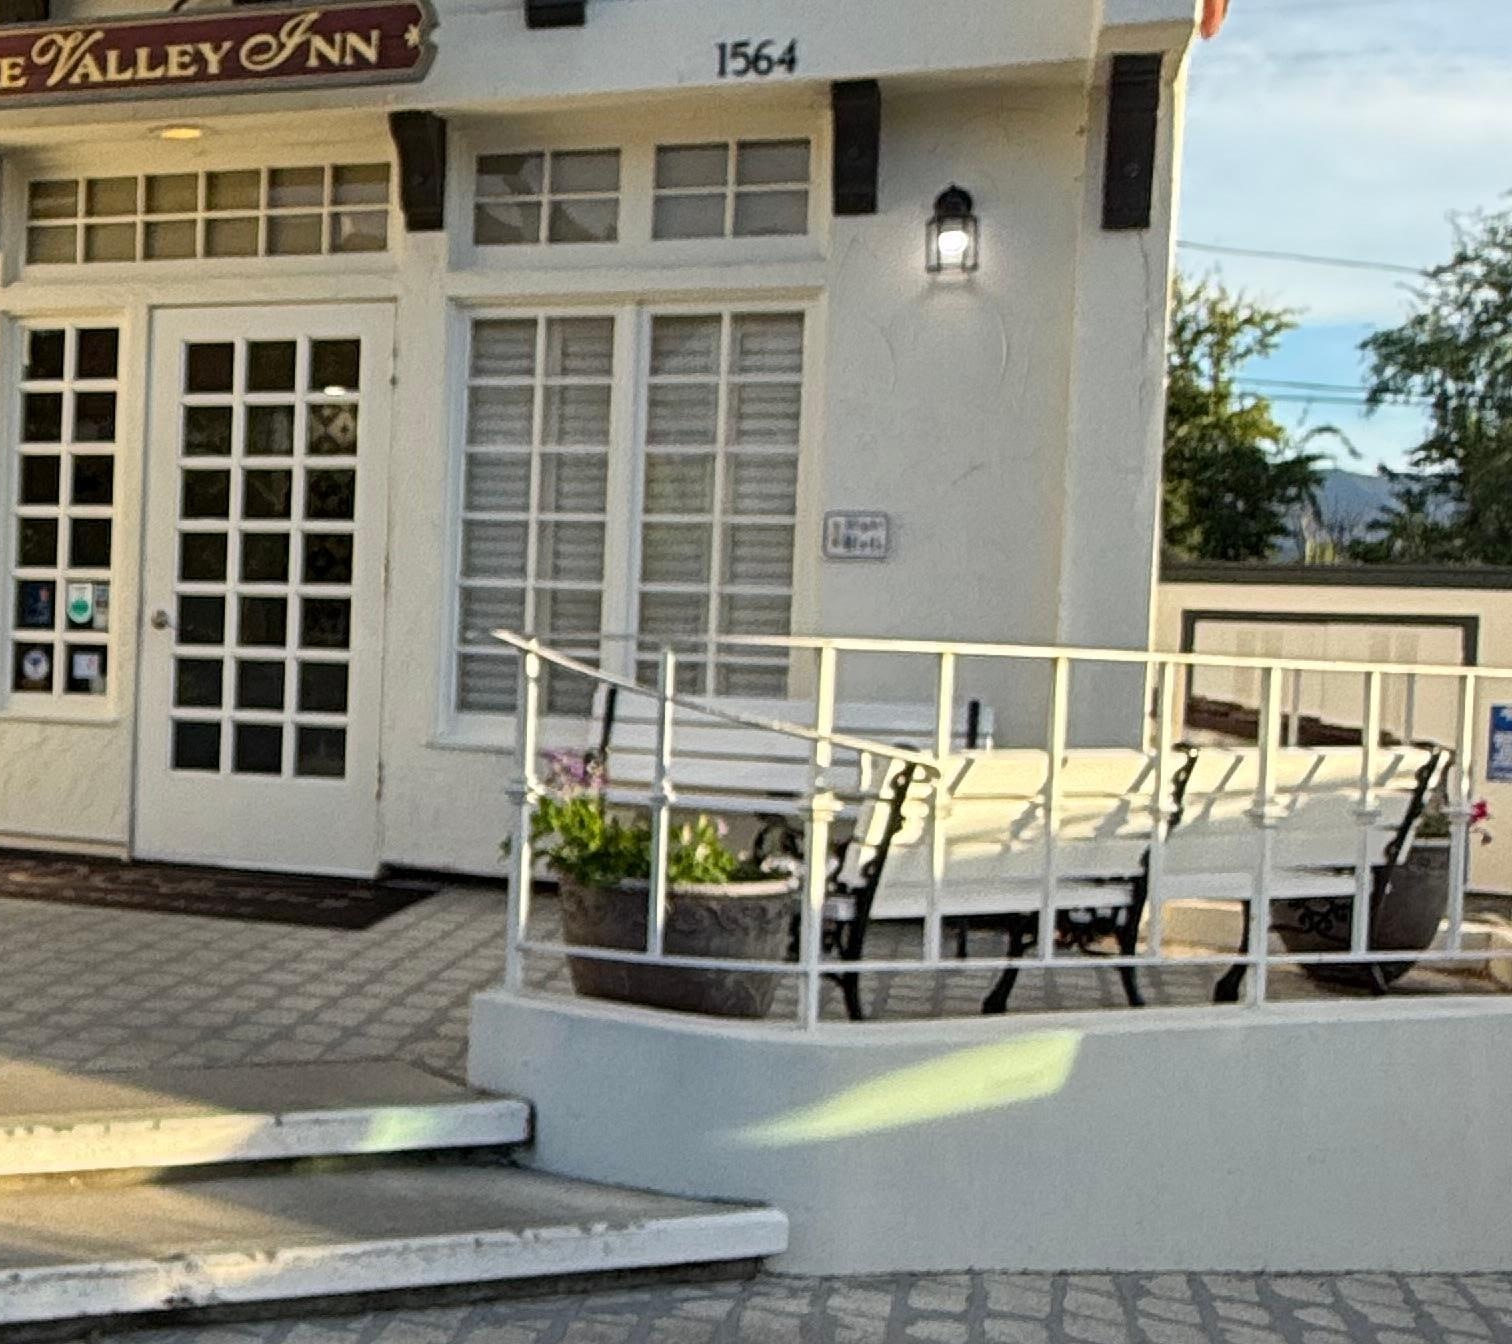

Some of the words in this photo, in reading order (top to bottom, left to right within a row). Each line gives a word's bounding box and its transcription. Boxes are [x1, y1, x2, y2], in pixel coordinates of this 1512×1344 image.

[31, 30, 232, 86] VALLEY
[240, 11, 380, 71] INN
[717, 38, 798, 77] 1564
